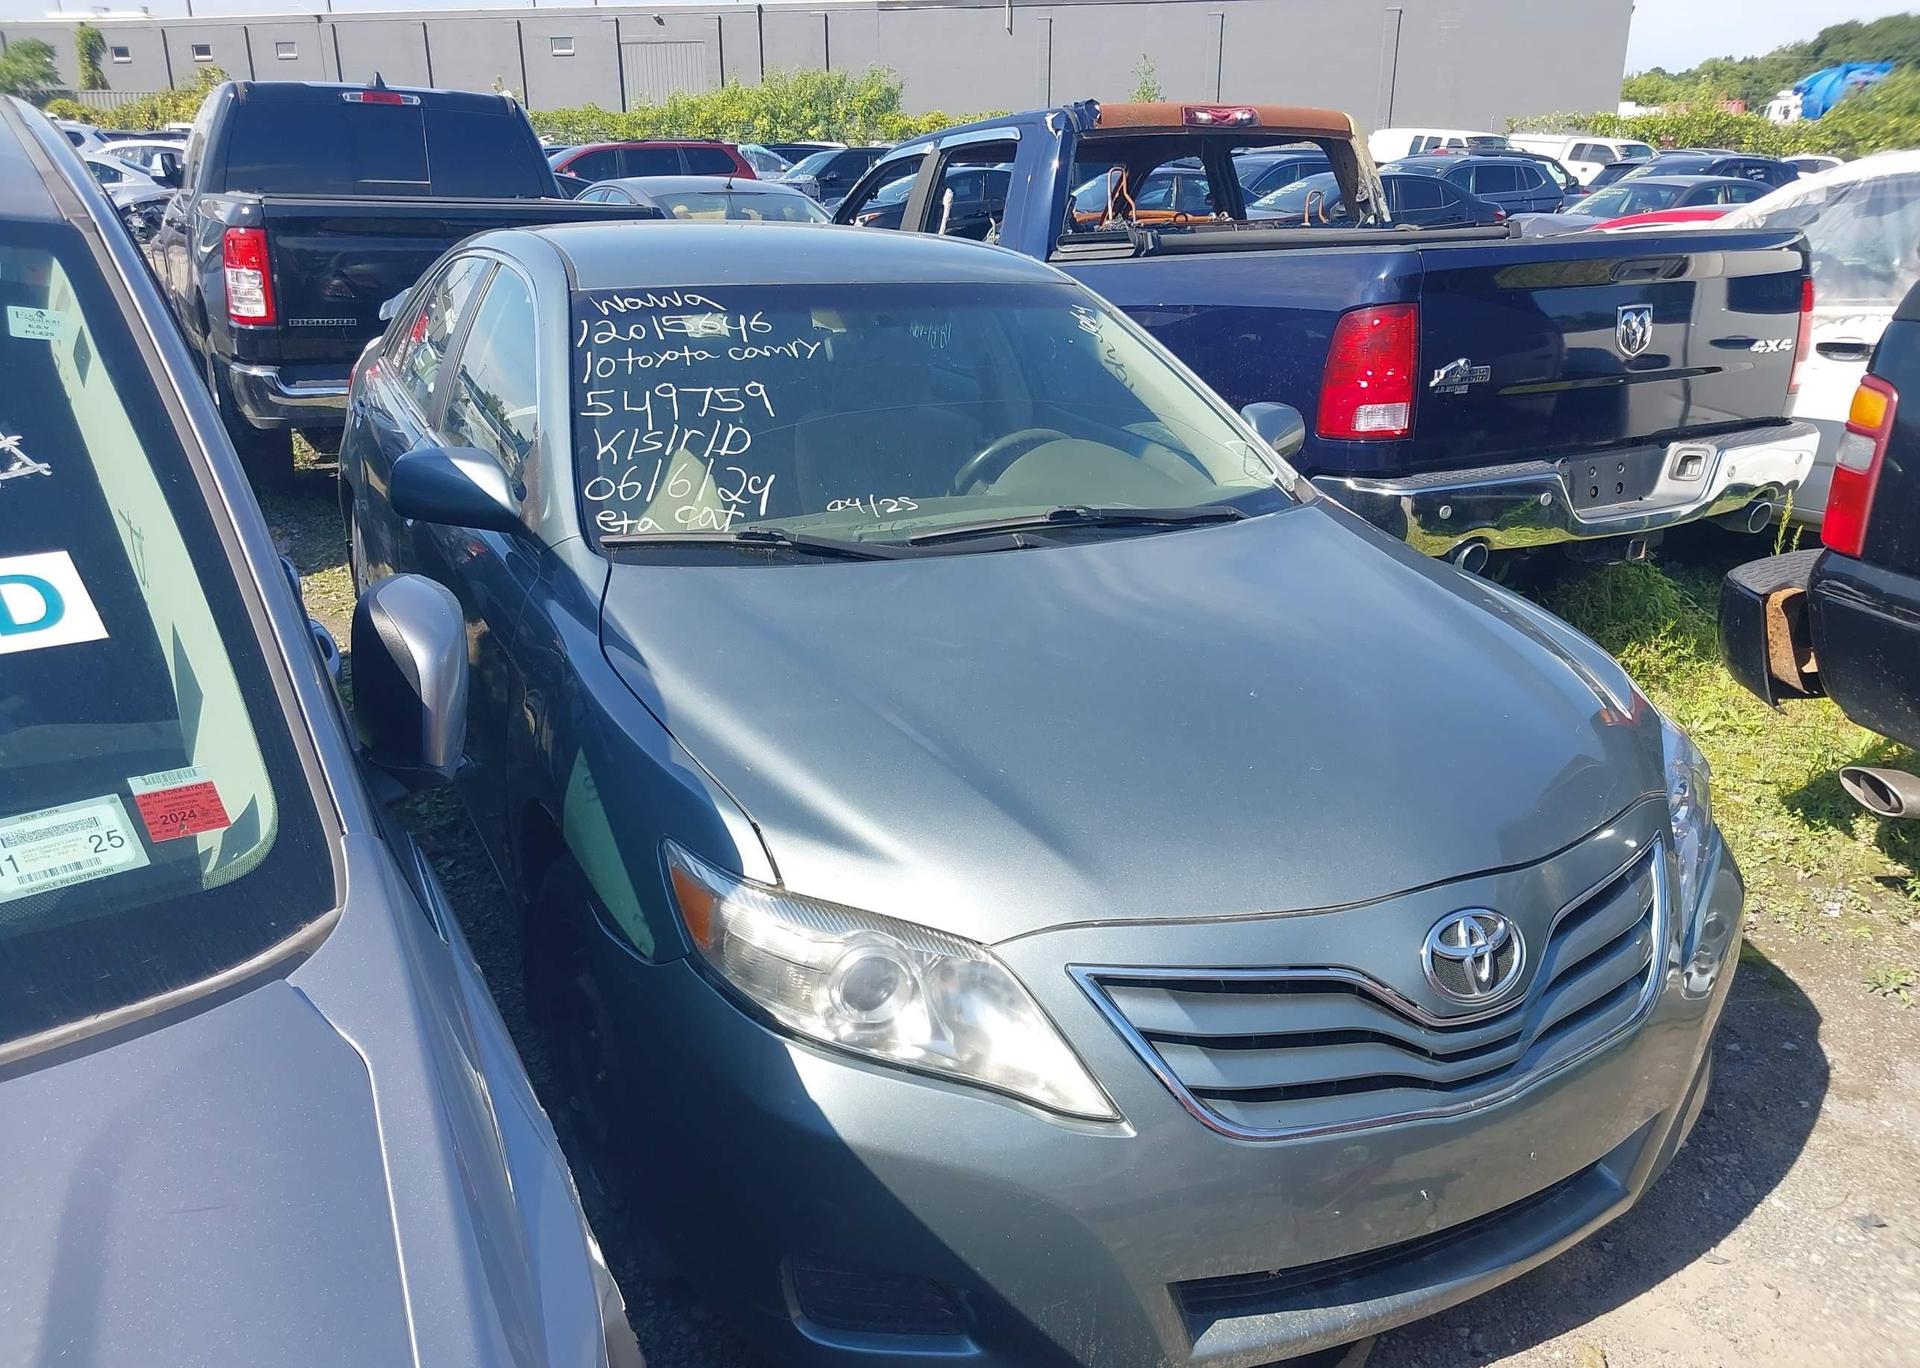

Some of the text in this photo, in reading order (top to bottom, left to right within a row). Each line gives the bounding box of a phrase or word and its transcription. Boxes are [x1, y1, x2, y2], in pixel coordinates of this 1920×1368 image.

[580, 380, 776, 431] 549759
[186, 783, 208, 793] STATE
[20, 808, 61, 822] NEW YORK
[159, 809, 198, 826] 2024
[88, 829, 125, 854] 25
[25, 867, 115, 894] VEHICLE REGISTRATION
